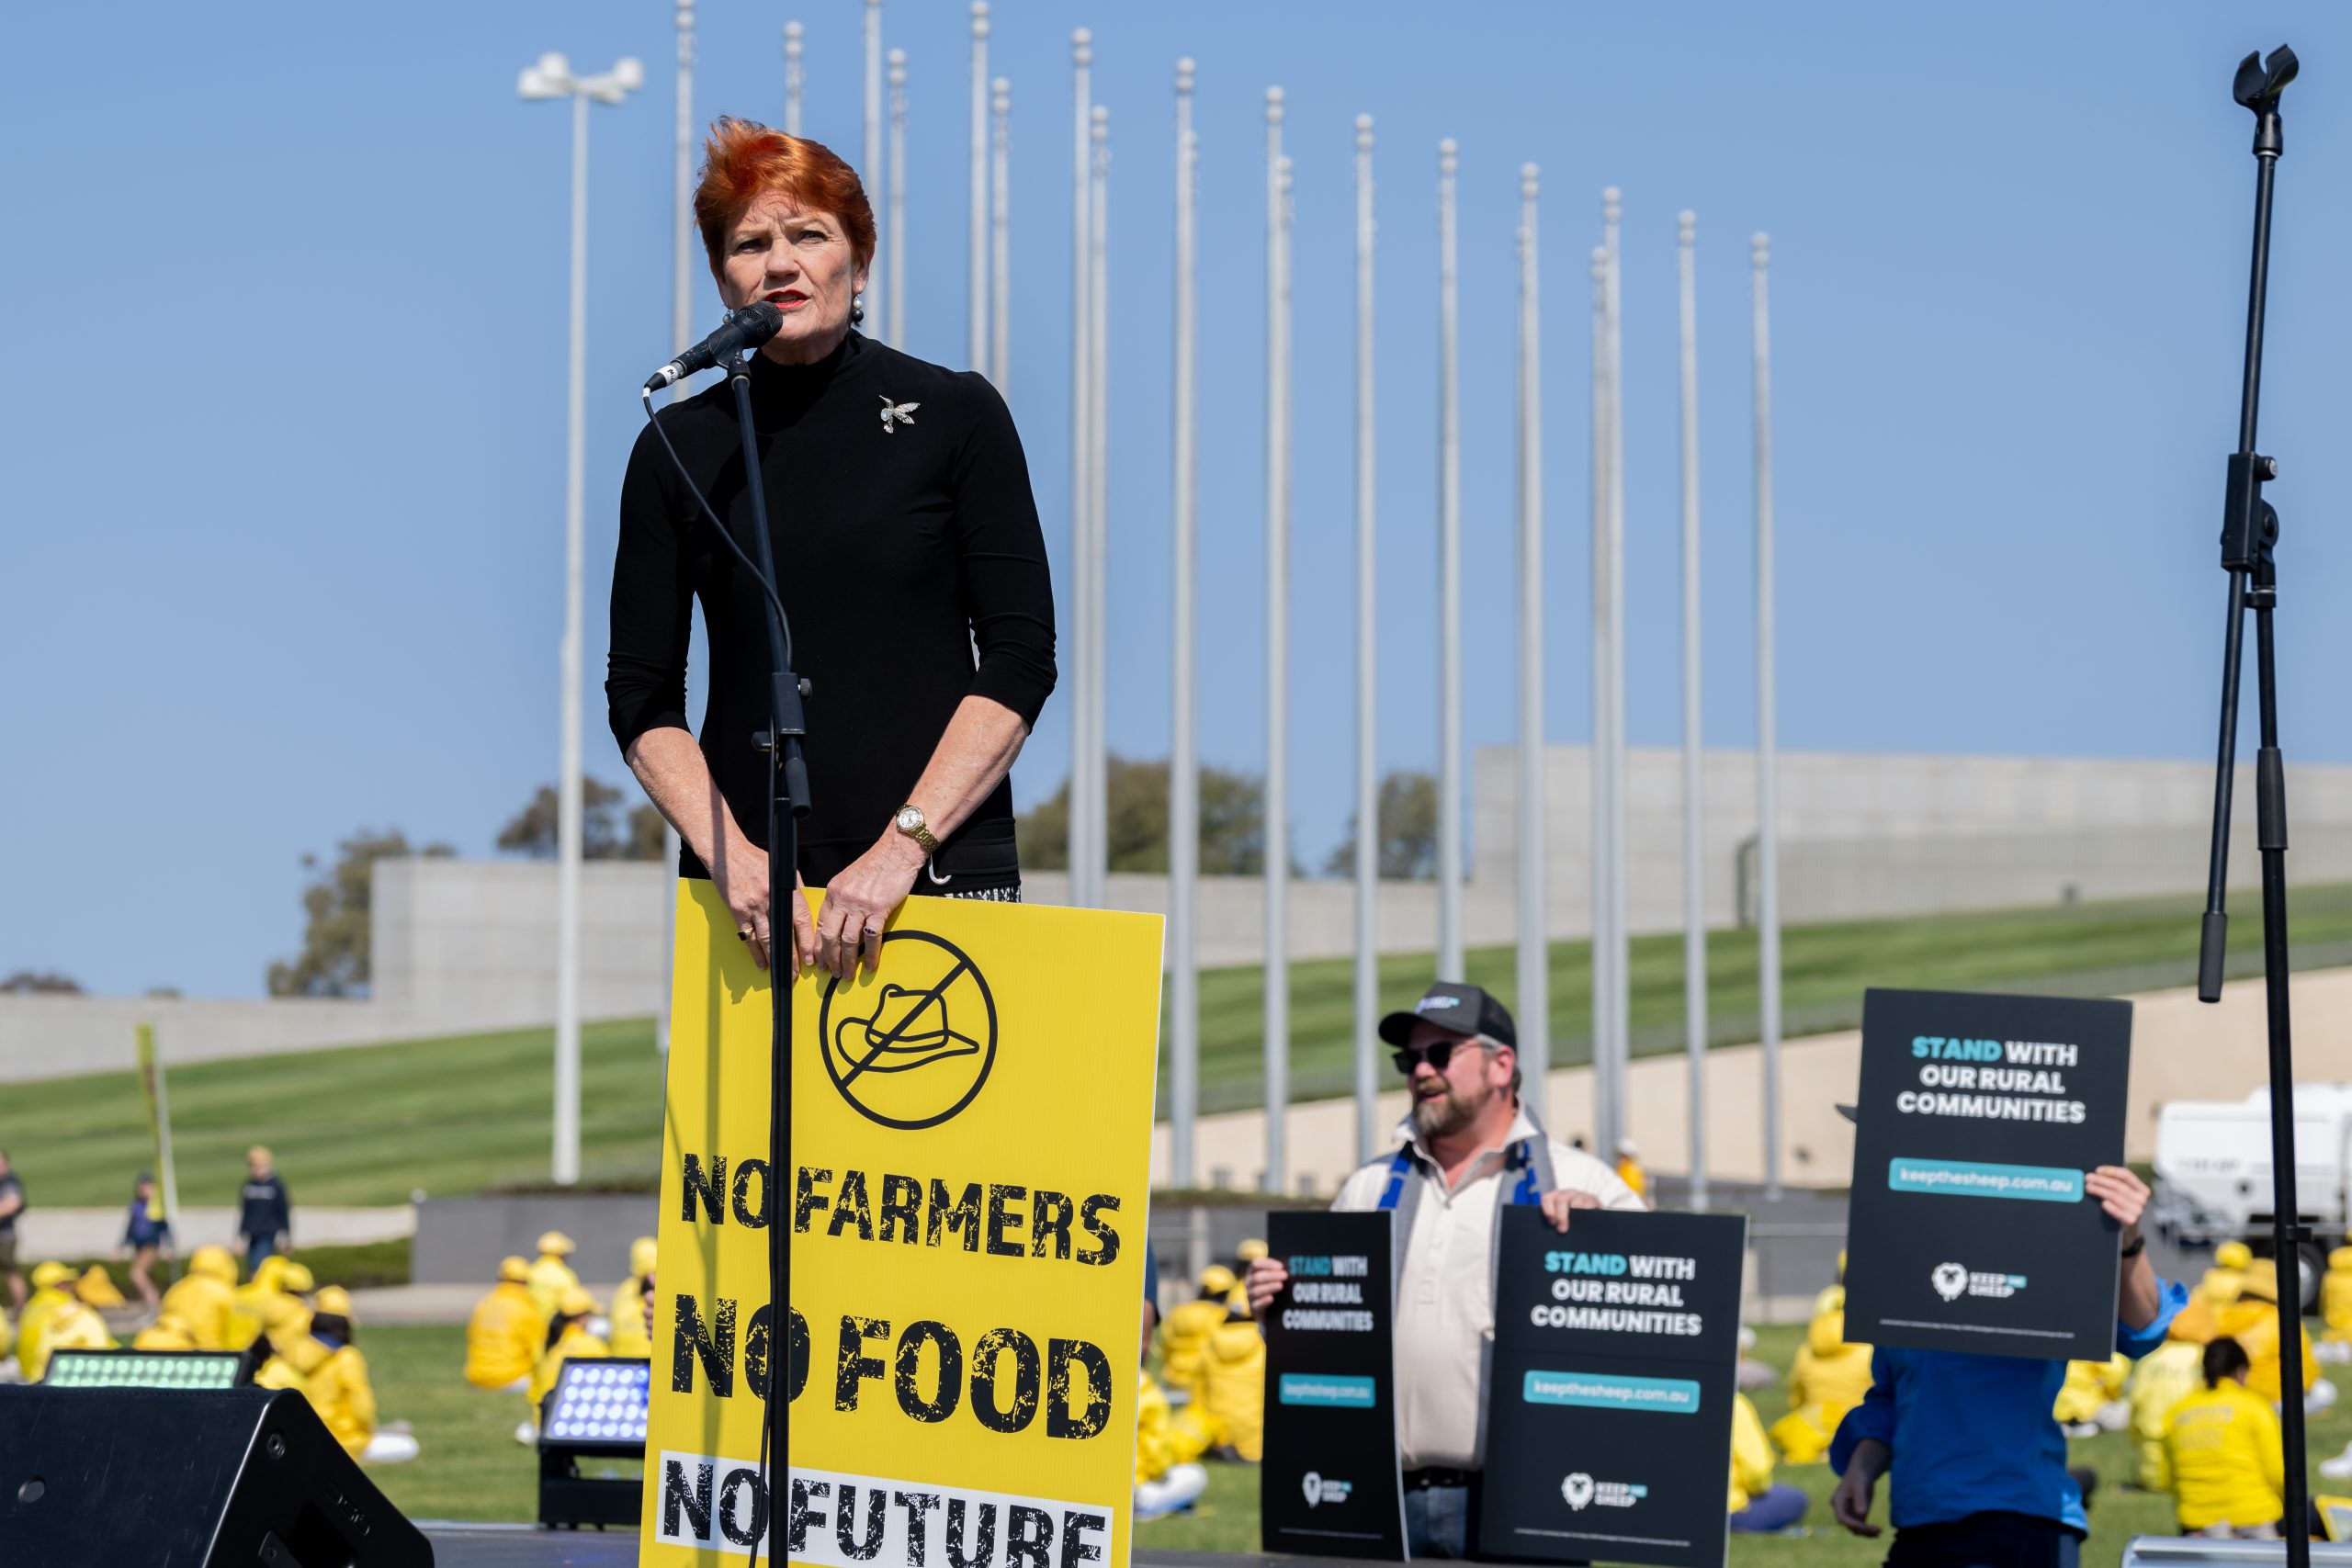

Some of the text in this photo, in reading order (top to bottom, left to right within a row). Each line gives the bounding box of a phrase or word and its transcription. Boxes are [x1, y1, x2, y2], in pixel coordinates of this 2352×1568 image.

[1912, 1036, 2078, 1066] STAND WITH
[1919, 1065, 2065, 1094] OUR RURAL
[1896, 1090, 2086, 1123] COMMUNITIES
[1899, 1168, 2073, 1192] keepthesheep.com.au
[682, 1154, 1122, 1267] NO FARMERS
[1288, 1255, 1368, 1277] STAND WITH
[1544, 1250, 1696, 1280] STAND WITH
[1969, 1272, 2007, 1285] KEEP
[1292, 1281, 1363, 1304] OUR RURAL
[1551, 1278, 1684, 1307] OUR RURAL
[1968, 1285, 2015, 1298] SHEEP
[1282, 1308, 1374, 1332] COMMUNITIES
[1530, 1303, 1702, 1336] COMMUNITIES
[672, 1293, 1113, 1440] NO FOOD
[1533, 1380, 1690, 1404] keepthesheep.com.au
[662, 1459, 770, 1546] NO
